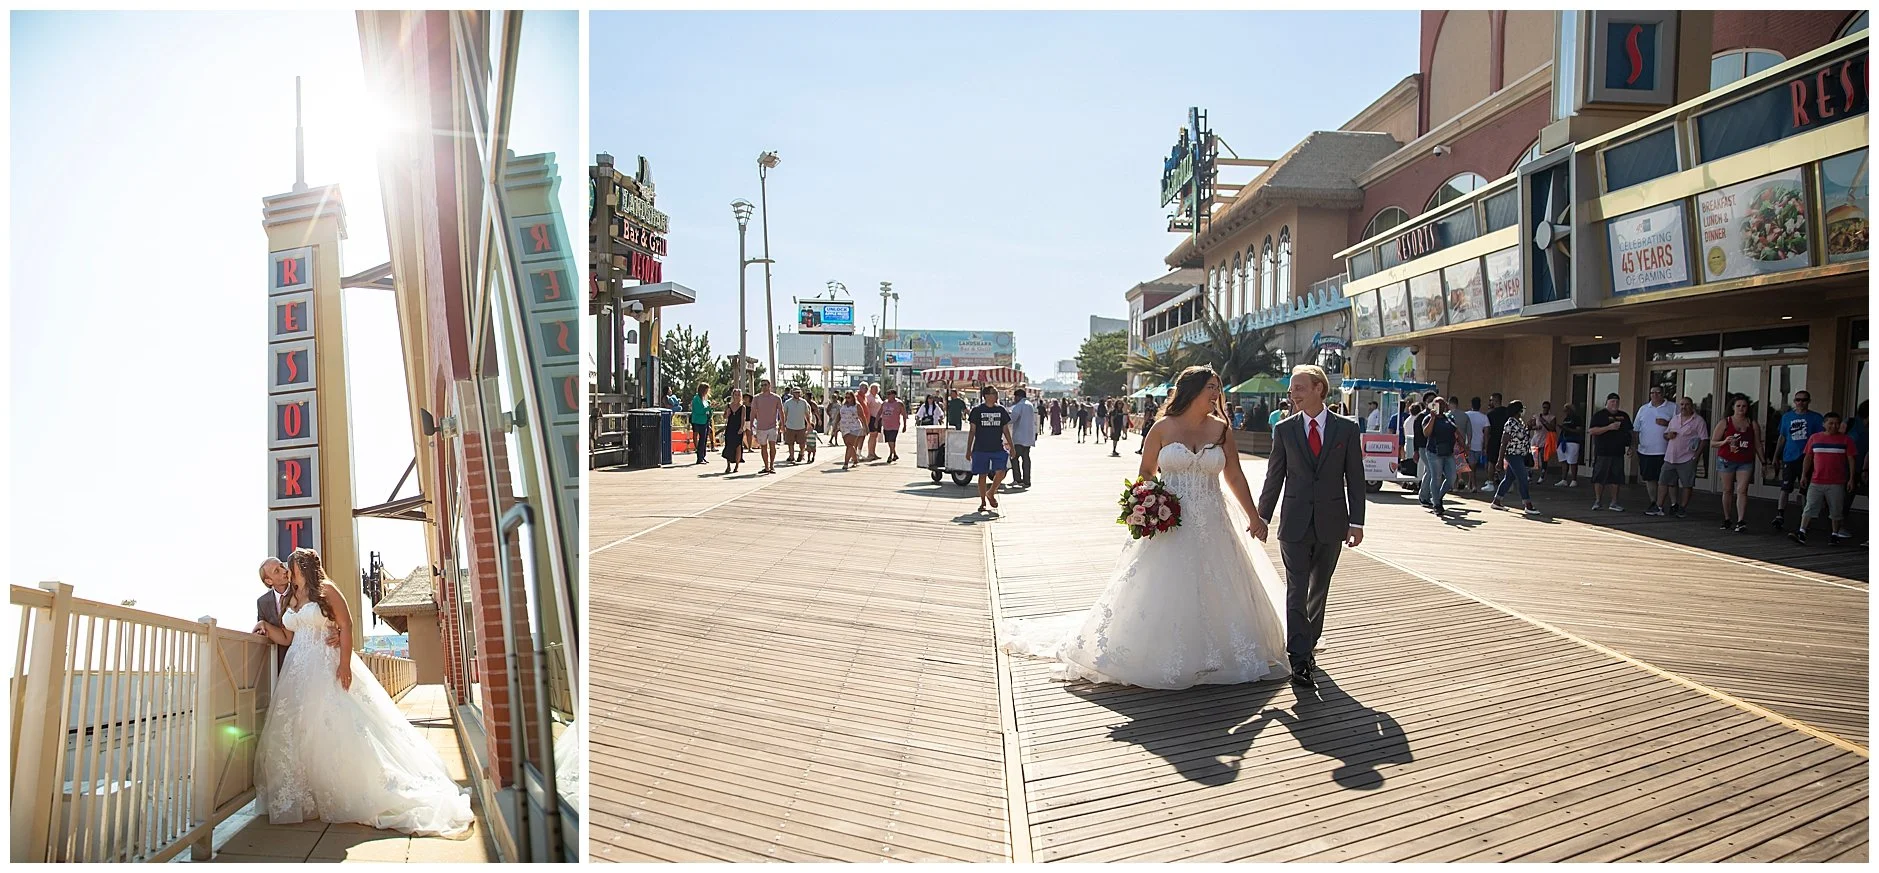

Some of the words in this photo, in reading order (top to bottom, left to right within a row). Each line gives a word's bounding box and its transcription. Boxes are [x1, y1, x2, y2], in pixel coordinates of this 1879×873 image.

[1702, 194, 1736, 213] BREAKFAST
[1704, 213, 1722, 227] LUNCH
[1724, 212, 1728, 223] &
[623, 219, 639, 244] Bar
[641, 228, 648, 247] &
[650, 231, 667, 256] Grill
[1396, 224, 1434, 261] RESORTS
[1619, 232, 1672, 251] CELEBRATING
[1705, 228, 1726, 242] DINNER
[1622, 252, 1634, 273] 45
[1636, 244, 1673, 271] YEARS
[1626, 275, 1635, 285] OF
[1638, 269, 1672, 283] GAMING
